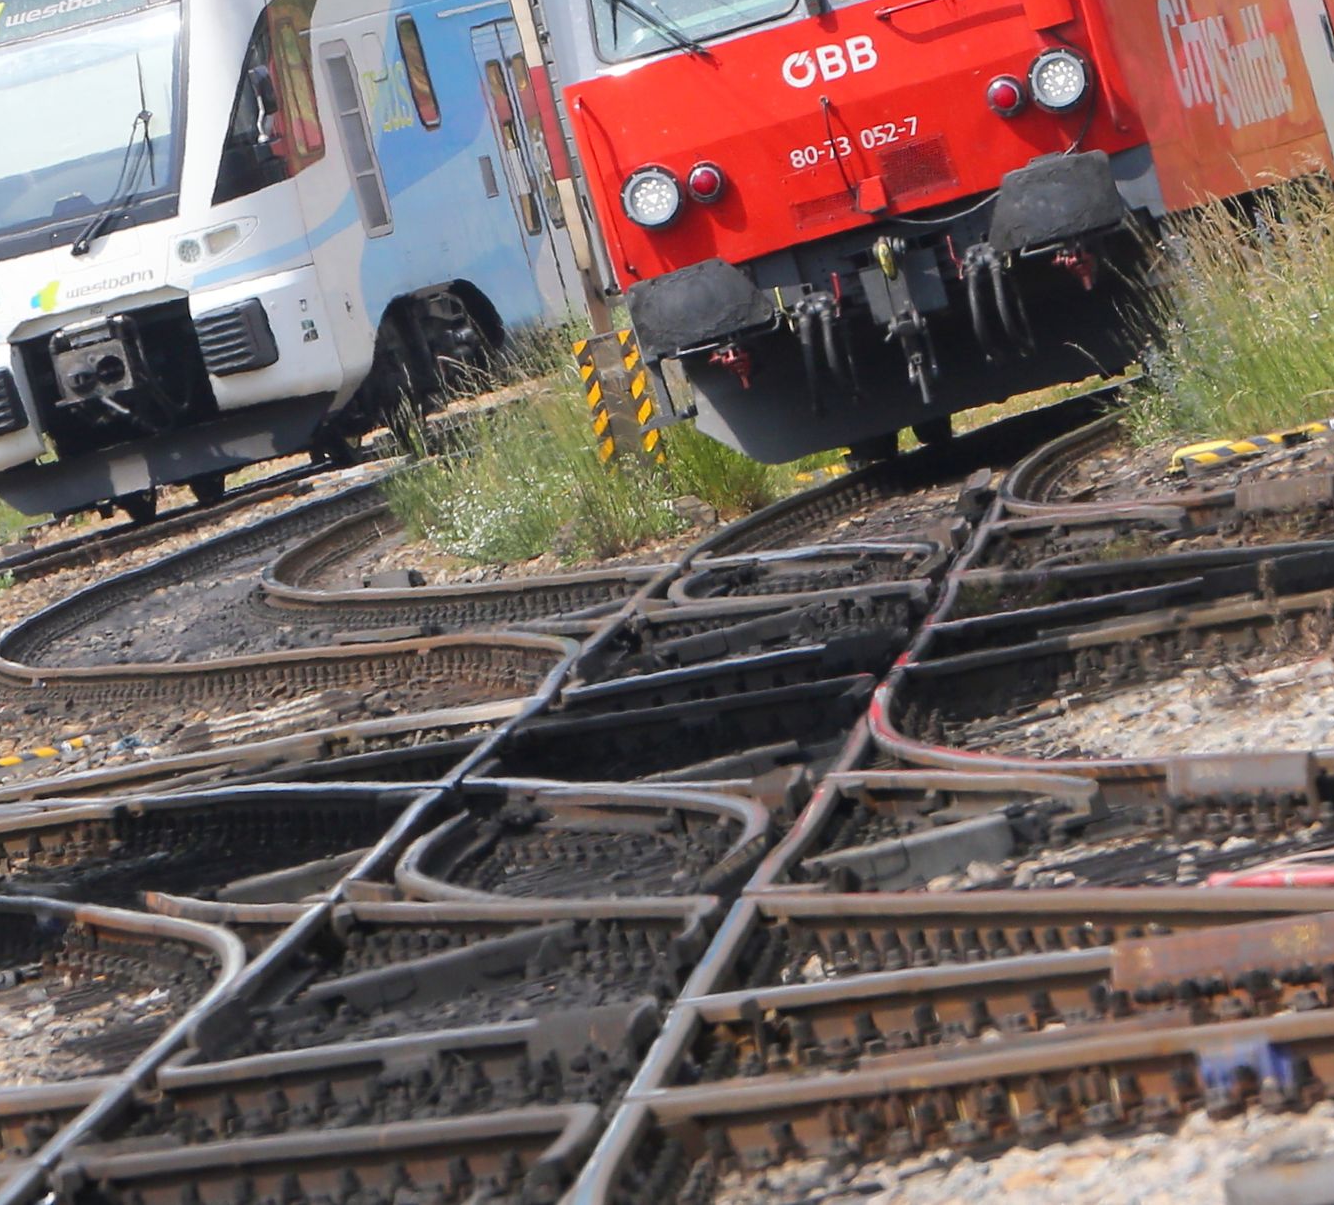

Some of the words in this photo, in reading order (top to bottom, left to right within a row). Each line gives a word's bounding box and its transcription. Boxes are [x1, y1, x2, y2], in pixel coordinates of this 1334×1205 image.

[781, 34, 879, 88] ÖBB
[789, 136, 852, 168] 80-73
[860, 116, 918, 149] 052-7
[66, 269, 154, 298] westbahn
